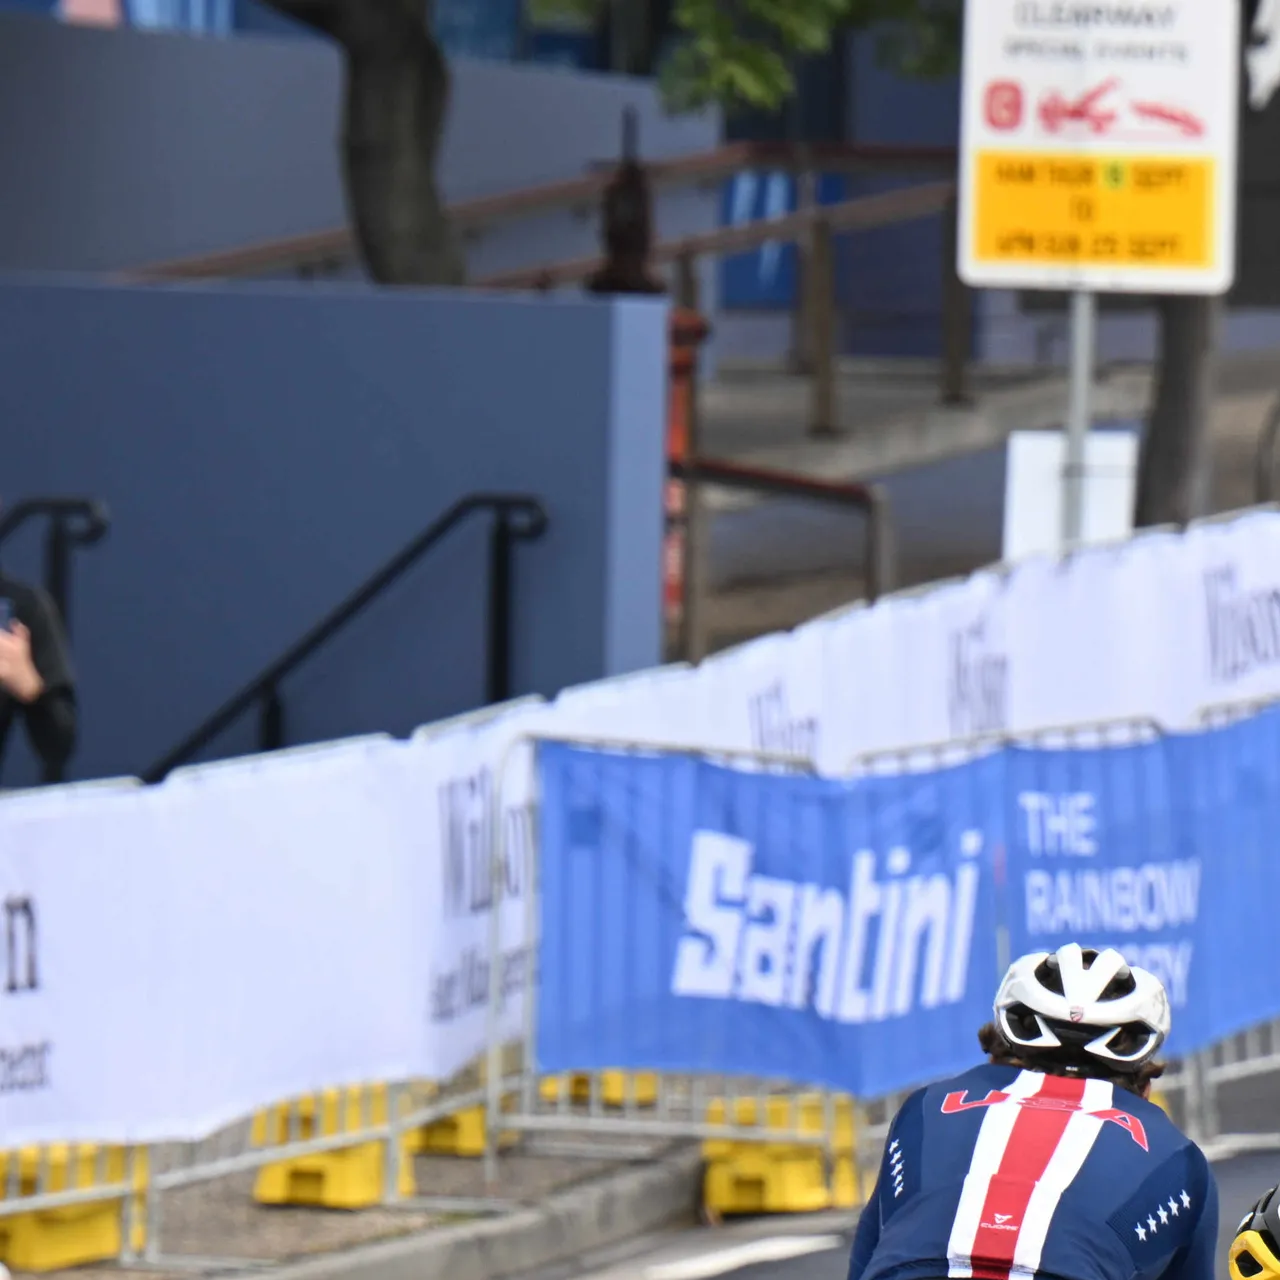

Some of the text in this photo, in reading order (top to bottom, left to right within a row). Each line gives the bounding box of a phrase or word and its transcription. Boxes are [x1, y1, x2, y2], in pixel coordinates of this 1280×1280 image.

[1017, 790, 1098, 858] THE
[670, 828, 984, 1024] Santini
[1023, 857, 1201, 936] RAINBOW
[940, 1088, 1150, 1153] USA
